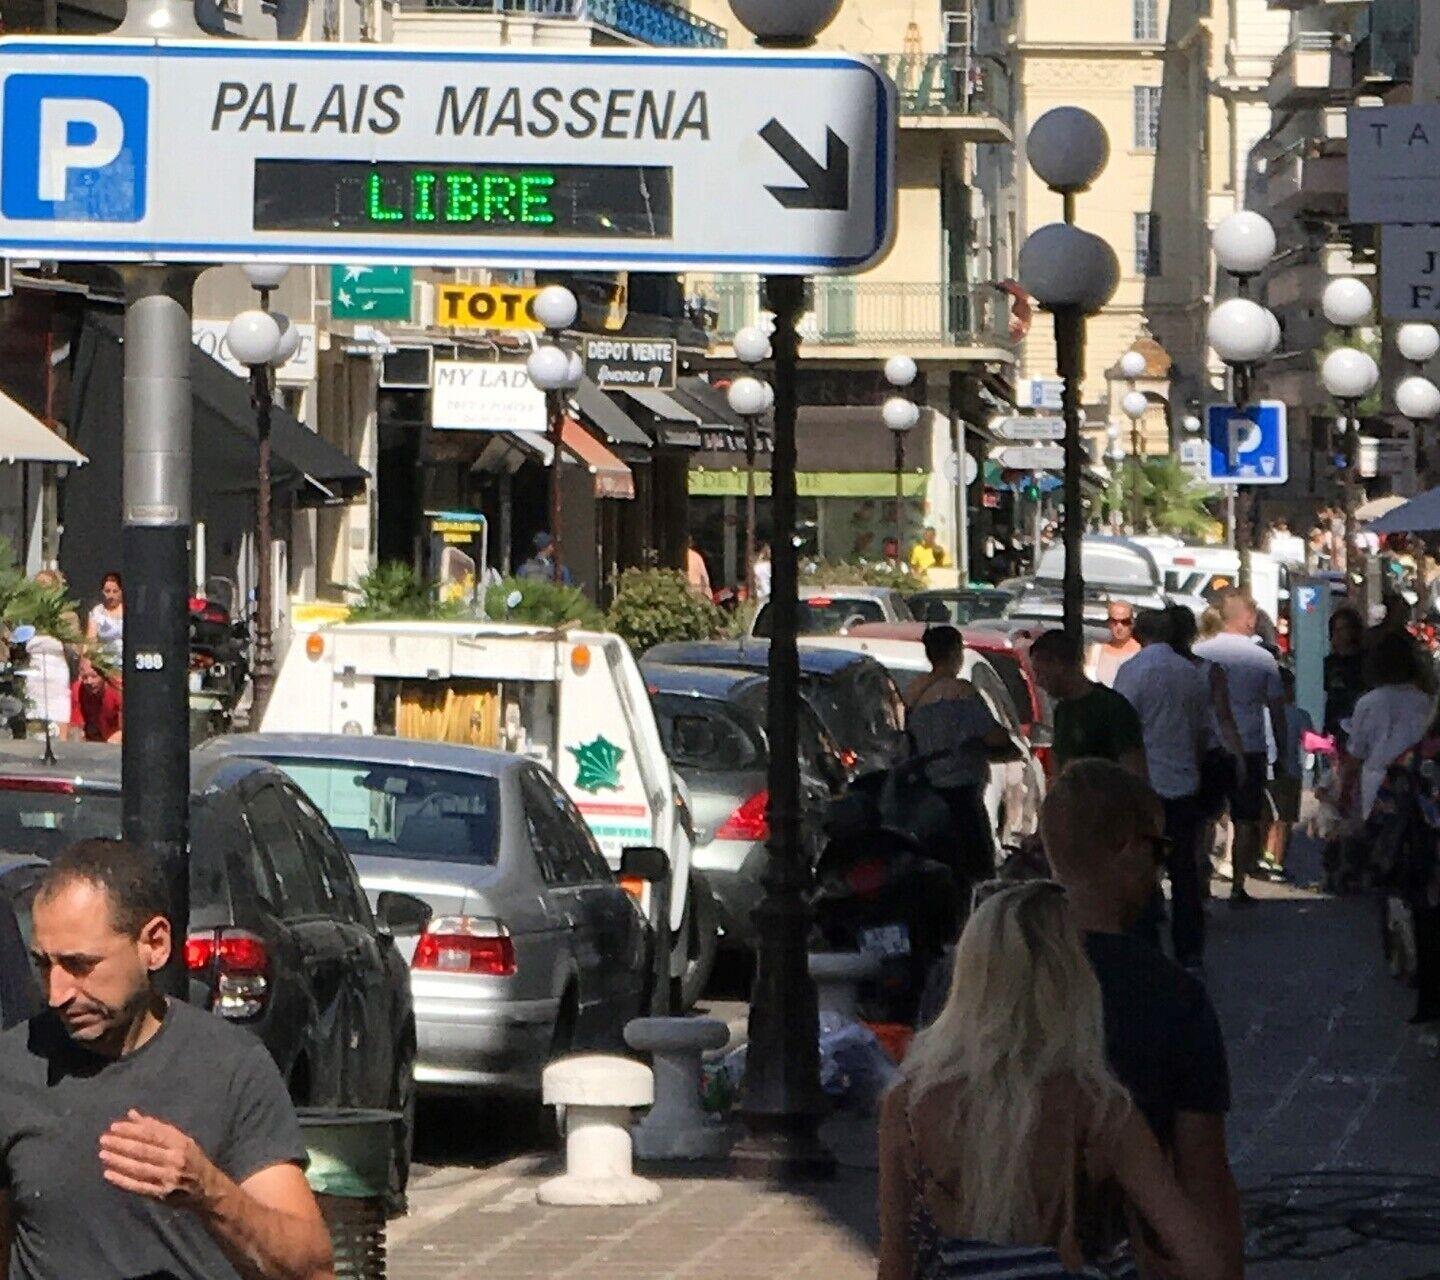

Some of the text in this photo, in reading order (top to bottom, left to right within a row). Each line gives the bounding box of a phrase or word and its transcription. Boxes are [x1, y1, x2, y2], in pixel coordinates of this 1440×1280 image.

[38, 81, 712, 202] P PALAIS MASSENA
[365, 173, 557, 225] LIBRE
[588, 341, 672, 362] DEPOT VENTE
[438, 368, 528, 388] MY LAD
[1227, 418, 1262, 467] P
